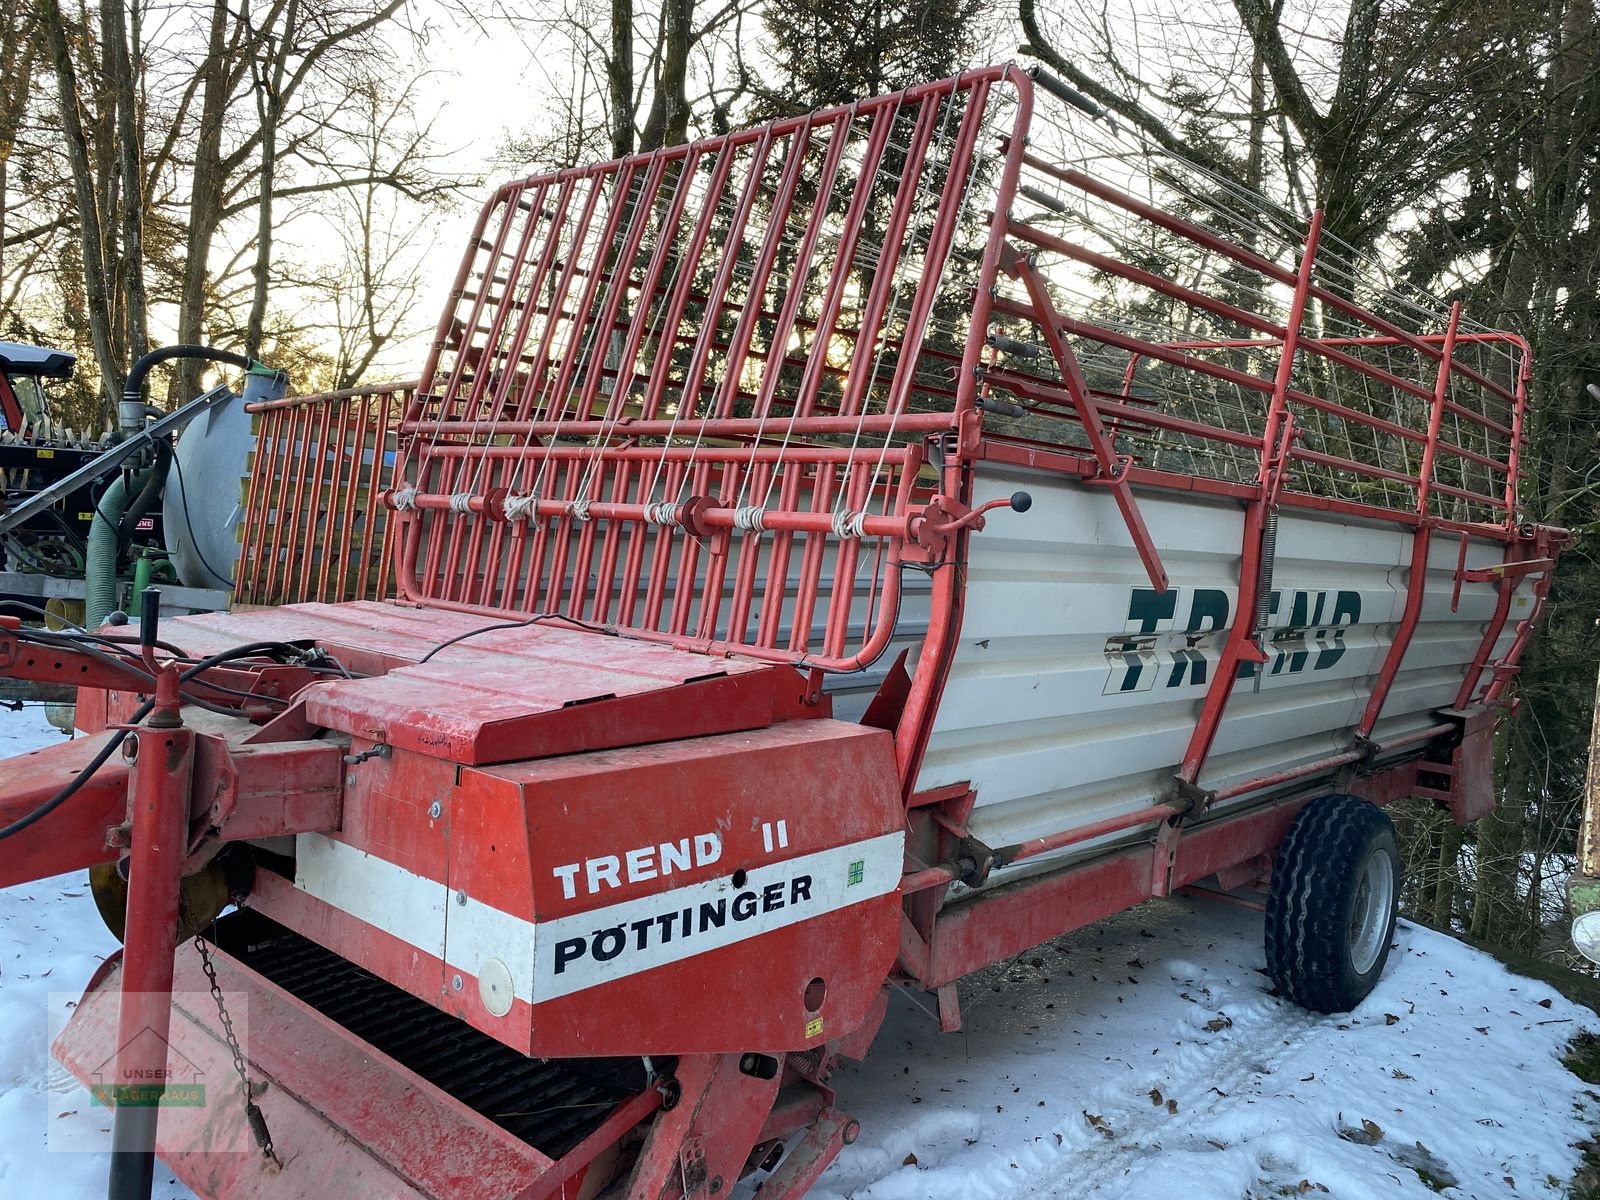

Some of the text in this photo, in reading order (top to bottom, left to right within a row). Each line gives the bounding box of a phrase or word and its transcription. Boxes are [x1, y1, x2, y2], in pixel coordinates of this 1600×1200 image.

[1120, 588, 1362, 692] TRND
[553, 819, 789, 900] TREND II
[554, 874, 813, 975] PÖTTINGER
